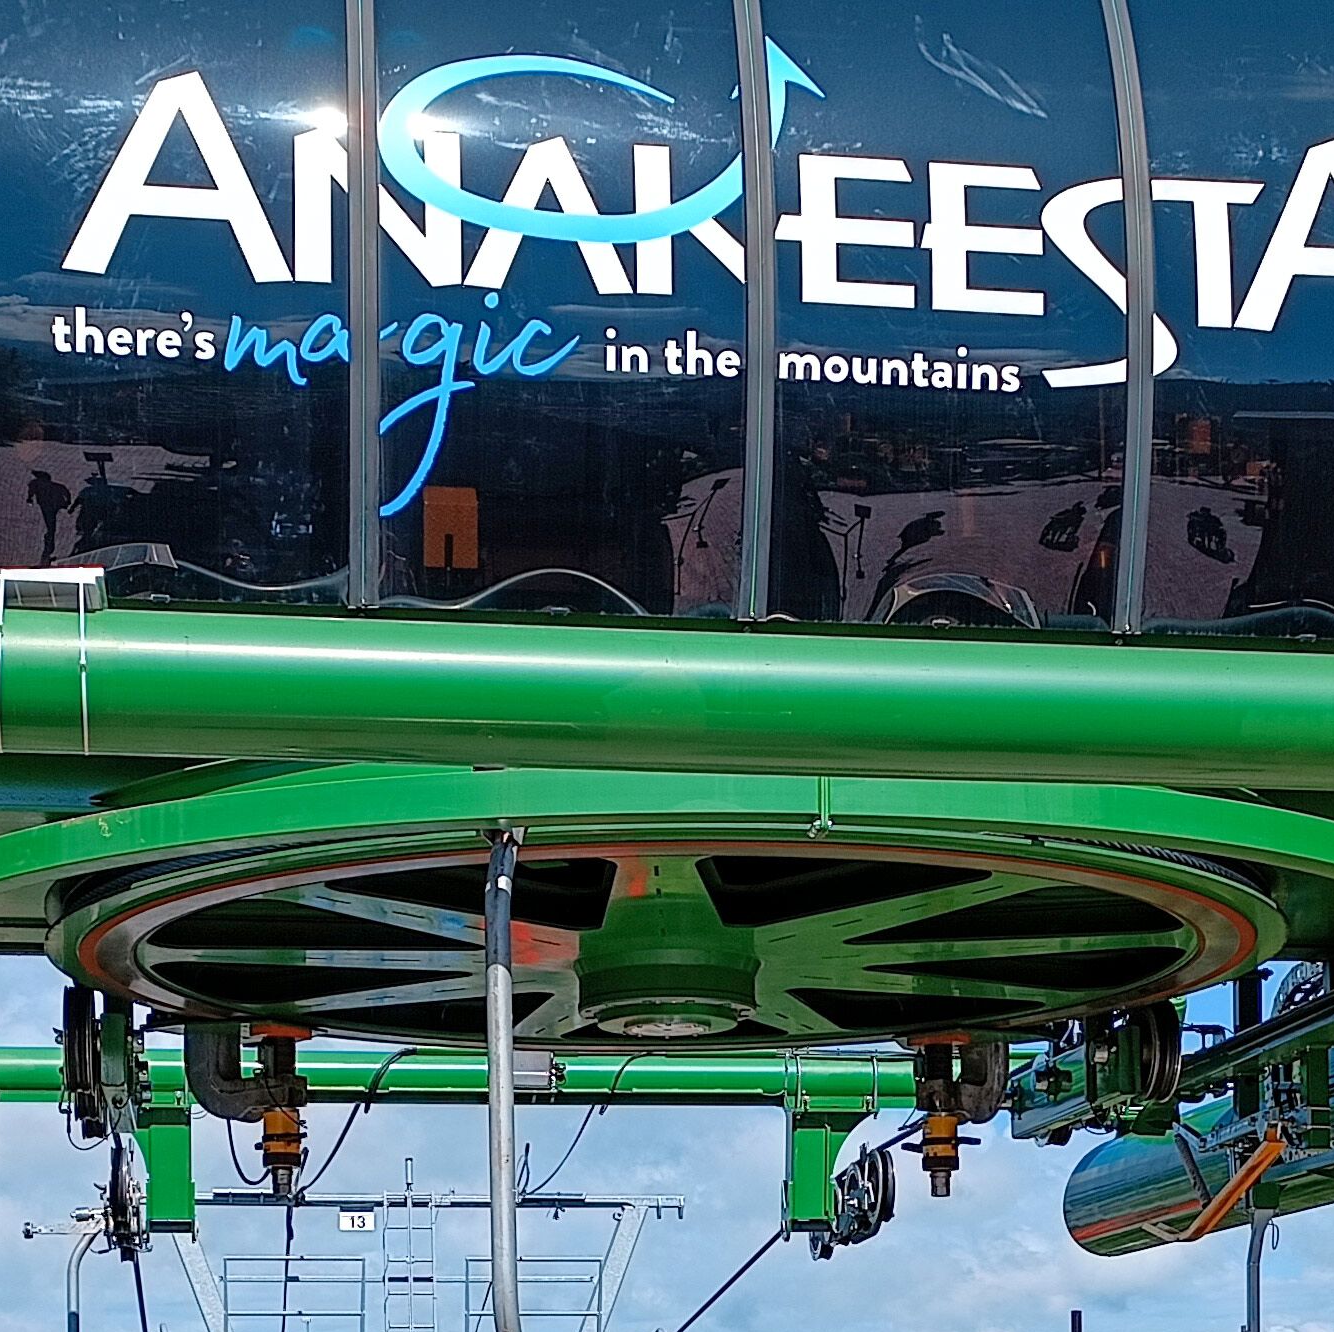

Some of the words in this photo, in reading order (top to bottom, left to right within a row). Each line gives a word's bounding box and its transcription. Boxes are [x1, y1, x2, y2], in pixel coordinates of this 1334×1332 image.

[51, 306, 215, 361] there's
[224, 292, 581, 518] magic
[604, 327, 651, 374] in
[664, 329, 742, 378] the
[778, 345, 1022, 393] mountains
[349, 1215, 366, 1229] 13
